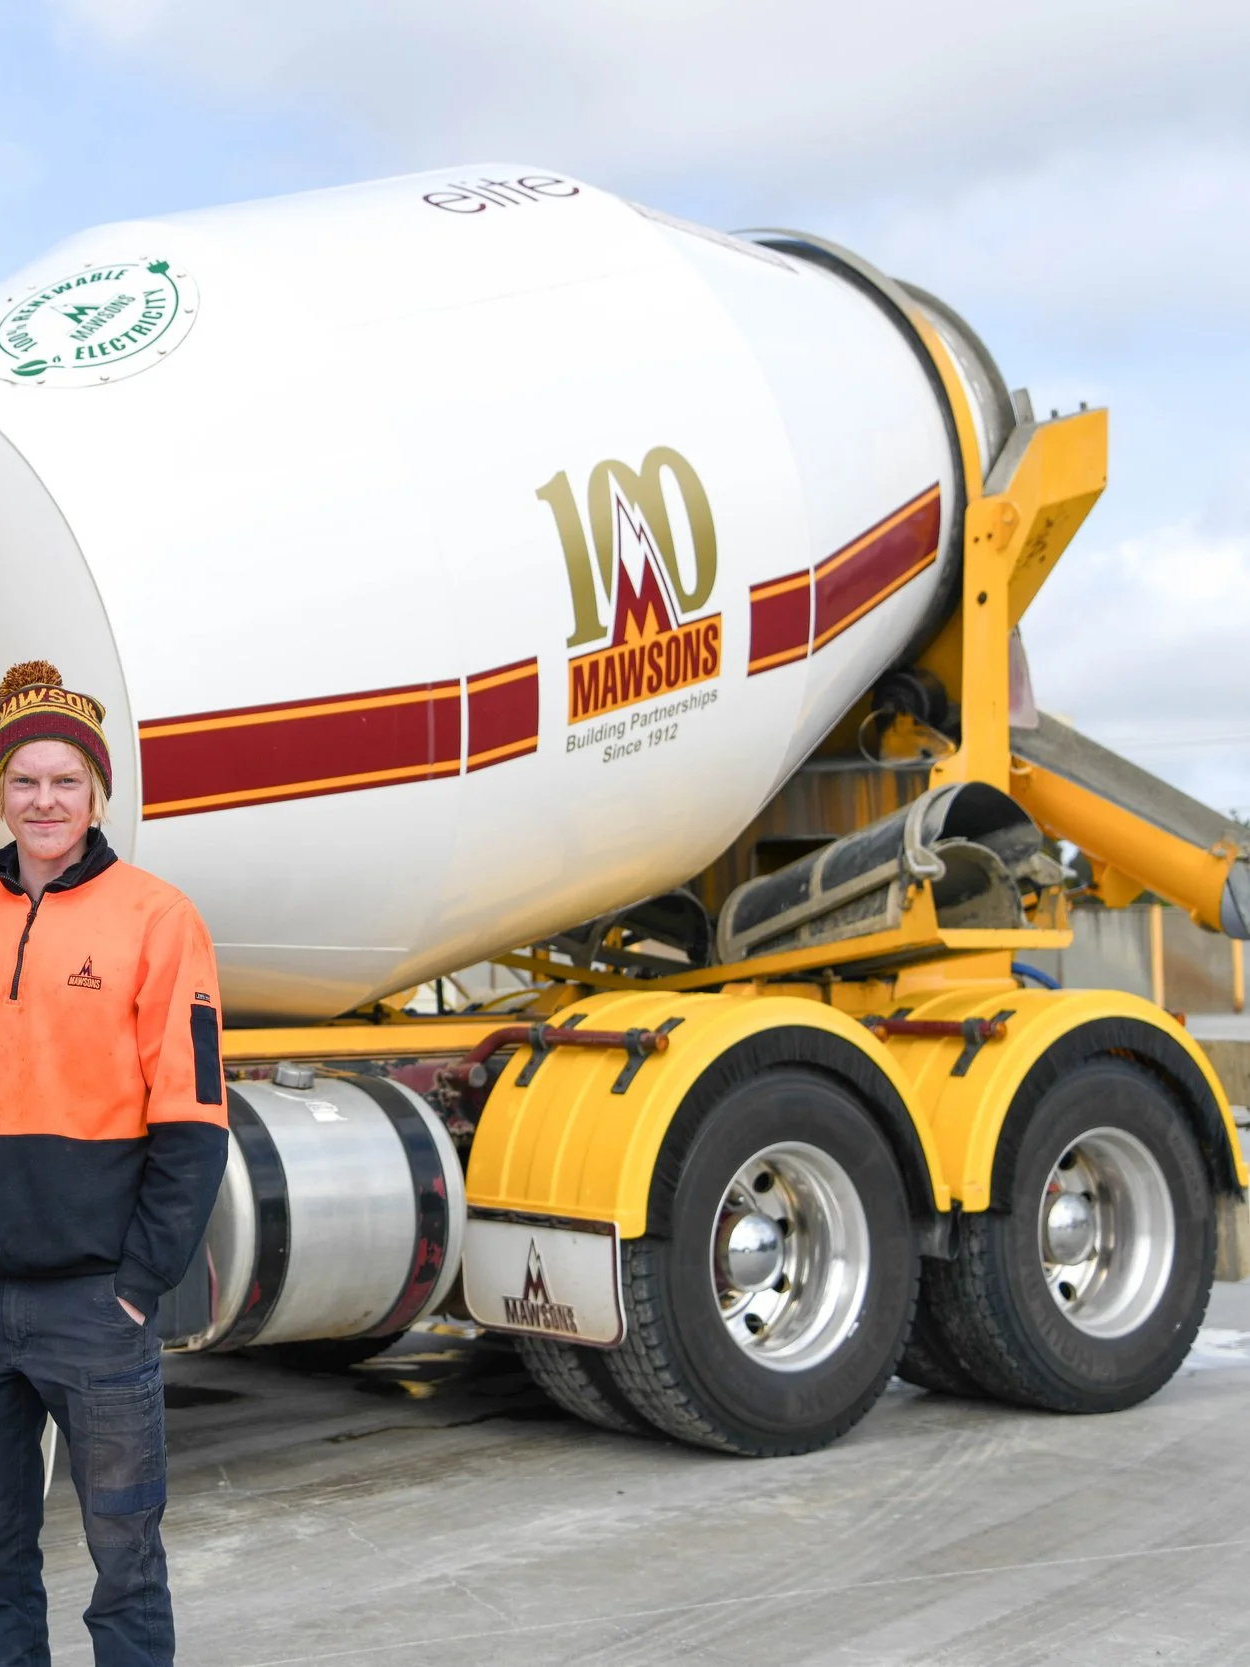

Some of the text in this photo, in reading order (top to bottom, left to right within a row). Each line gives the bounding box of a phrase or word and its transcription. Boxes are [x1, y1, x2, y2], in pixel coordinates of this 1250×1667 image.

[423, 176, 579, 213] elite
[11, 269, 129, 322] RENEWABLE
[69, 294, 136, 342] MAWSONS
[75, 288, 166, 360] ELECTRICITY
[535, 445, 718, 648] 100
[571, 623, 719, 719] MAWSONS
[566, 688, 718, 754] Building Partnerships
[602, 723, 679, 764] Since 1912
[68, 976, 101, 990] MAWSONS
[503, 1299, 578, 1334] MAWSONS
